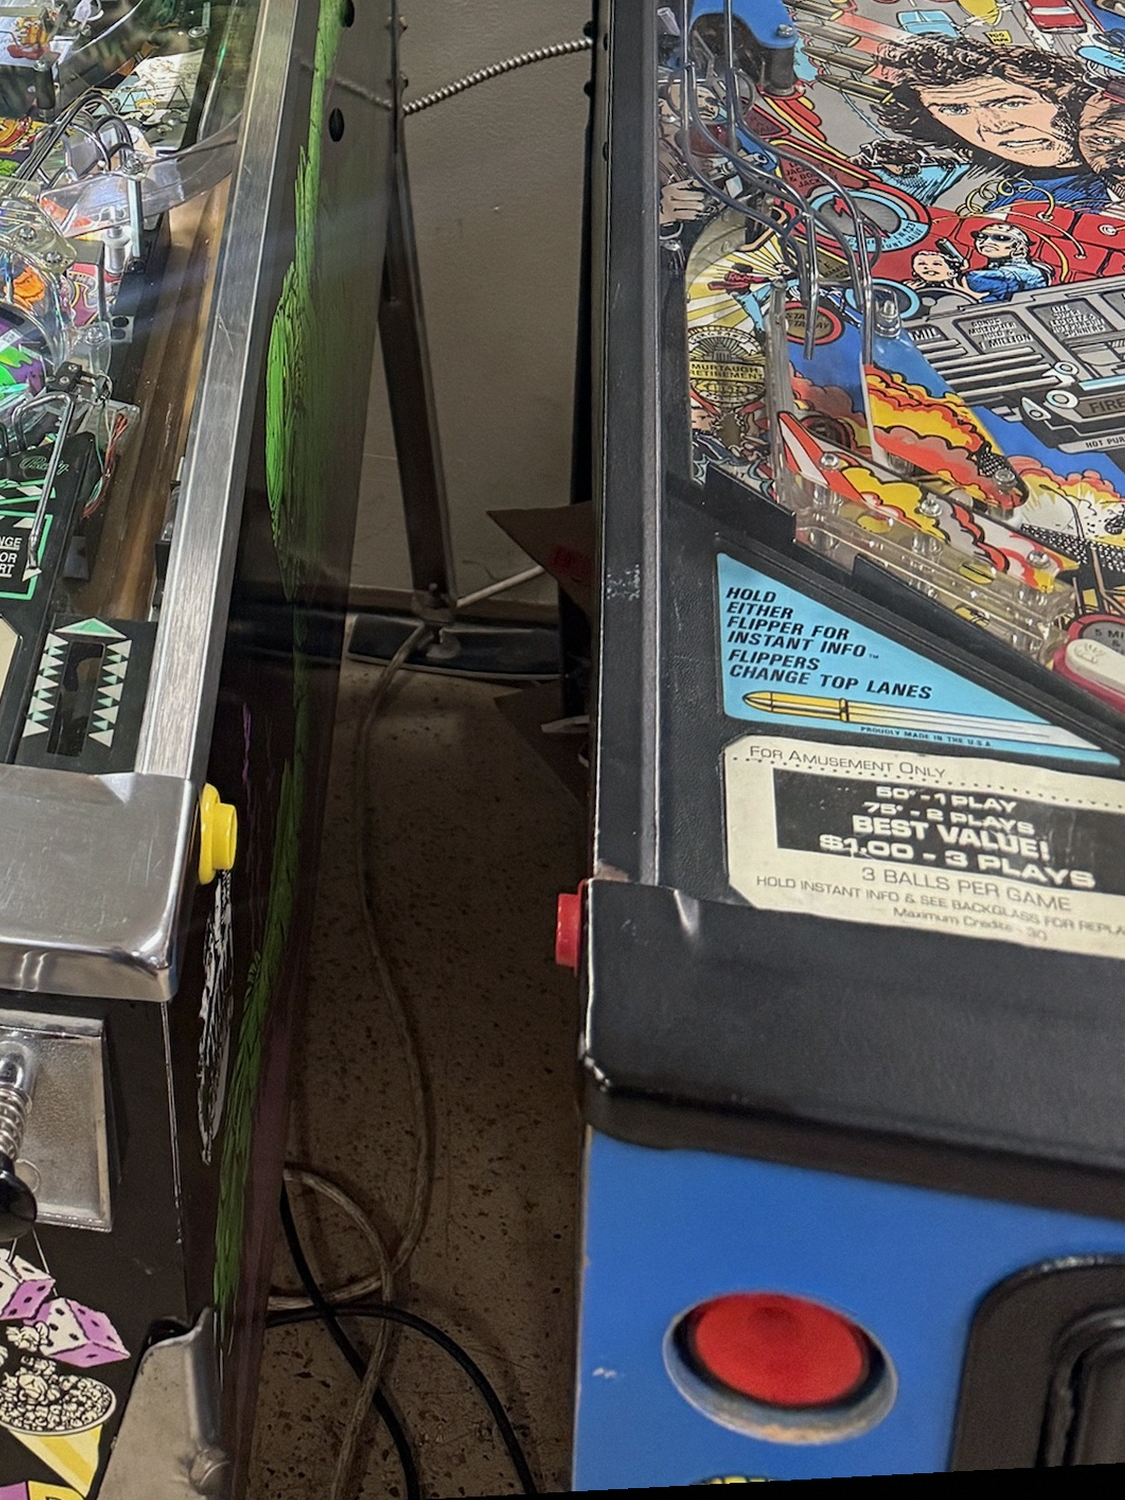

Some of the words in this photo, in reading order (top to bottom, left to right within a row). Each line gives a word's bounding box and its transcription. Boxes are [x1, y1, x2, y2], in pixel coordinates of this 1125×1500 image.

[988, 333, 1034, 349] MILLION
[1085, 440, 1104, 449] HOT
[725, 587, 777, 603] HOLD
[726, 601, 794, 619] EITHER
[726, 616, 805, 637] FLIPPER
[811, 625, 851, 641] FOR
[727, 630, 814, 651] INSTANT
[819, 641, 867, 658] INFO
[728, 649, 821, 671] FLIPPERS
[729, 664, 812, 685] CHANGE
[820, 674, 859, 690] TOP
[866, 680, 934, 700] LANES
[860, 726, 901, 737] PROUDLY
[904, 731, 930, 741] MADE
[933, 735, 944, 743] IN
[946, 736, 965, 744] THE
[951, 794, 1018, 814] PLAY
[925, 808, 945, 823] 2
[949, 810, 1037, 835] PLAYS
[851, 815, 929, 840] BEST
[936, 825, 1050, 861] VALUE!
[818, 834, 915, 861] $1.00
[944, 850, 969, 868] 3
[977, 854, 1096, 889] PLAYS
[862, 867, 877, 882] 3
[883, 869, 951, 891] BALLS
[957, 879, 1000, 898] PER
[1005, 886, 1073, 911] GAME
[755, 875, 797, 890] HOLD
[800, 880, 862, 899] INSTANT
[865, 888, 900, 902] INFO
[919, 894, 948, 908] SEE
[951, 899, 1041, 924] BACKGLASS
[1043, 914, 1075, 930] FOR
[892, 905, 960, 926] Maximum
